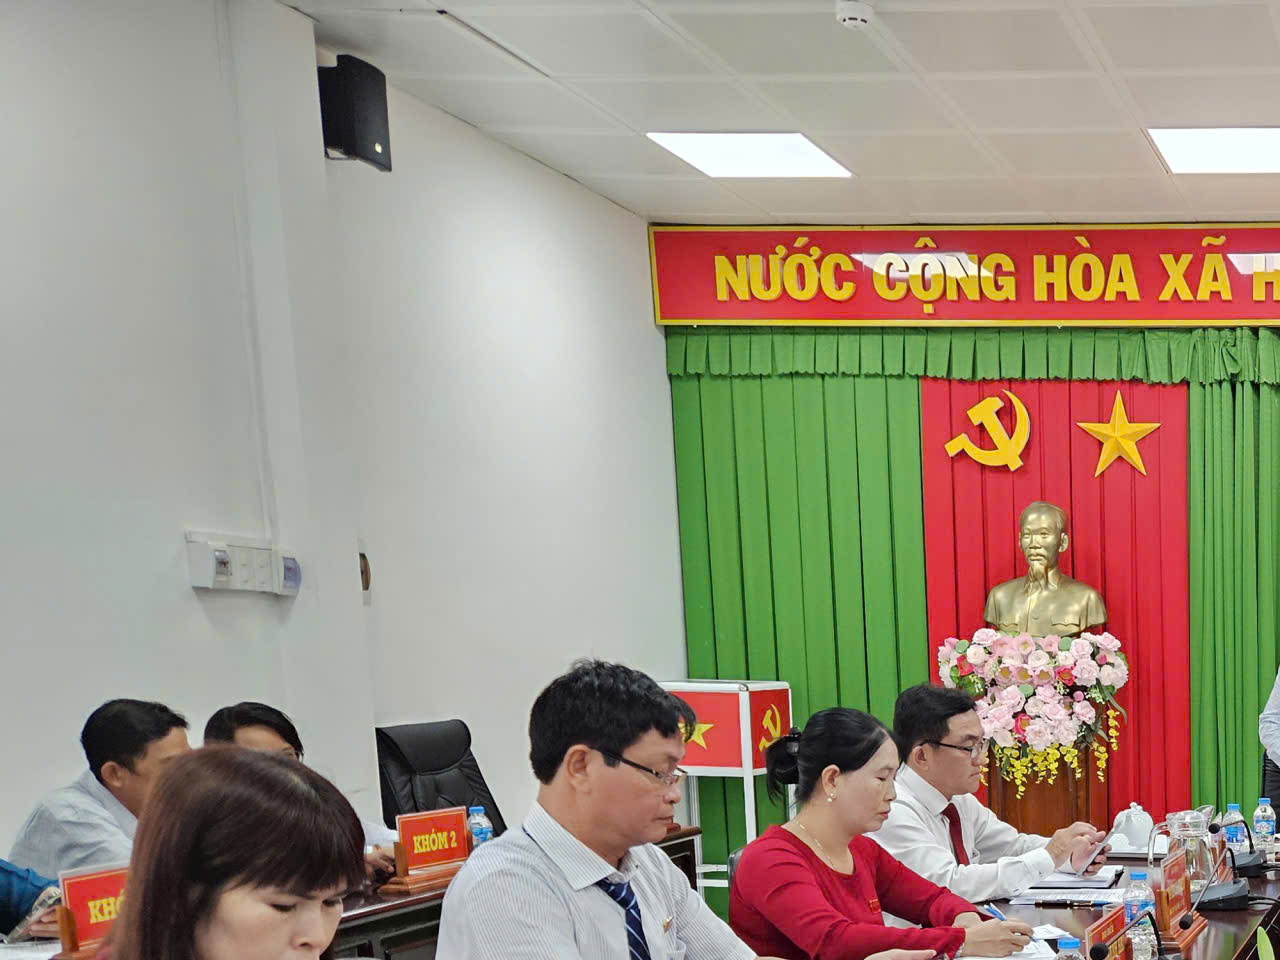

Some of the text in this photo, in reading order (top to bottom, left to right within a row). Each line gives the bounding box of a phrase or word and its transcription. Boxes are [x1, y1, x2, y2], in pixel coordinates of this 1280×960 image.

[714, 237, 857, 301] NƯỚC
[873, 236, 1017, 314] CỘNG
[1034, 236, 1141, 302] HÒA
[1159, 235, 1233, 301] XÃ
[413, 828, 458, 854] KHÓM 2
